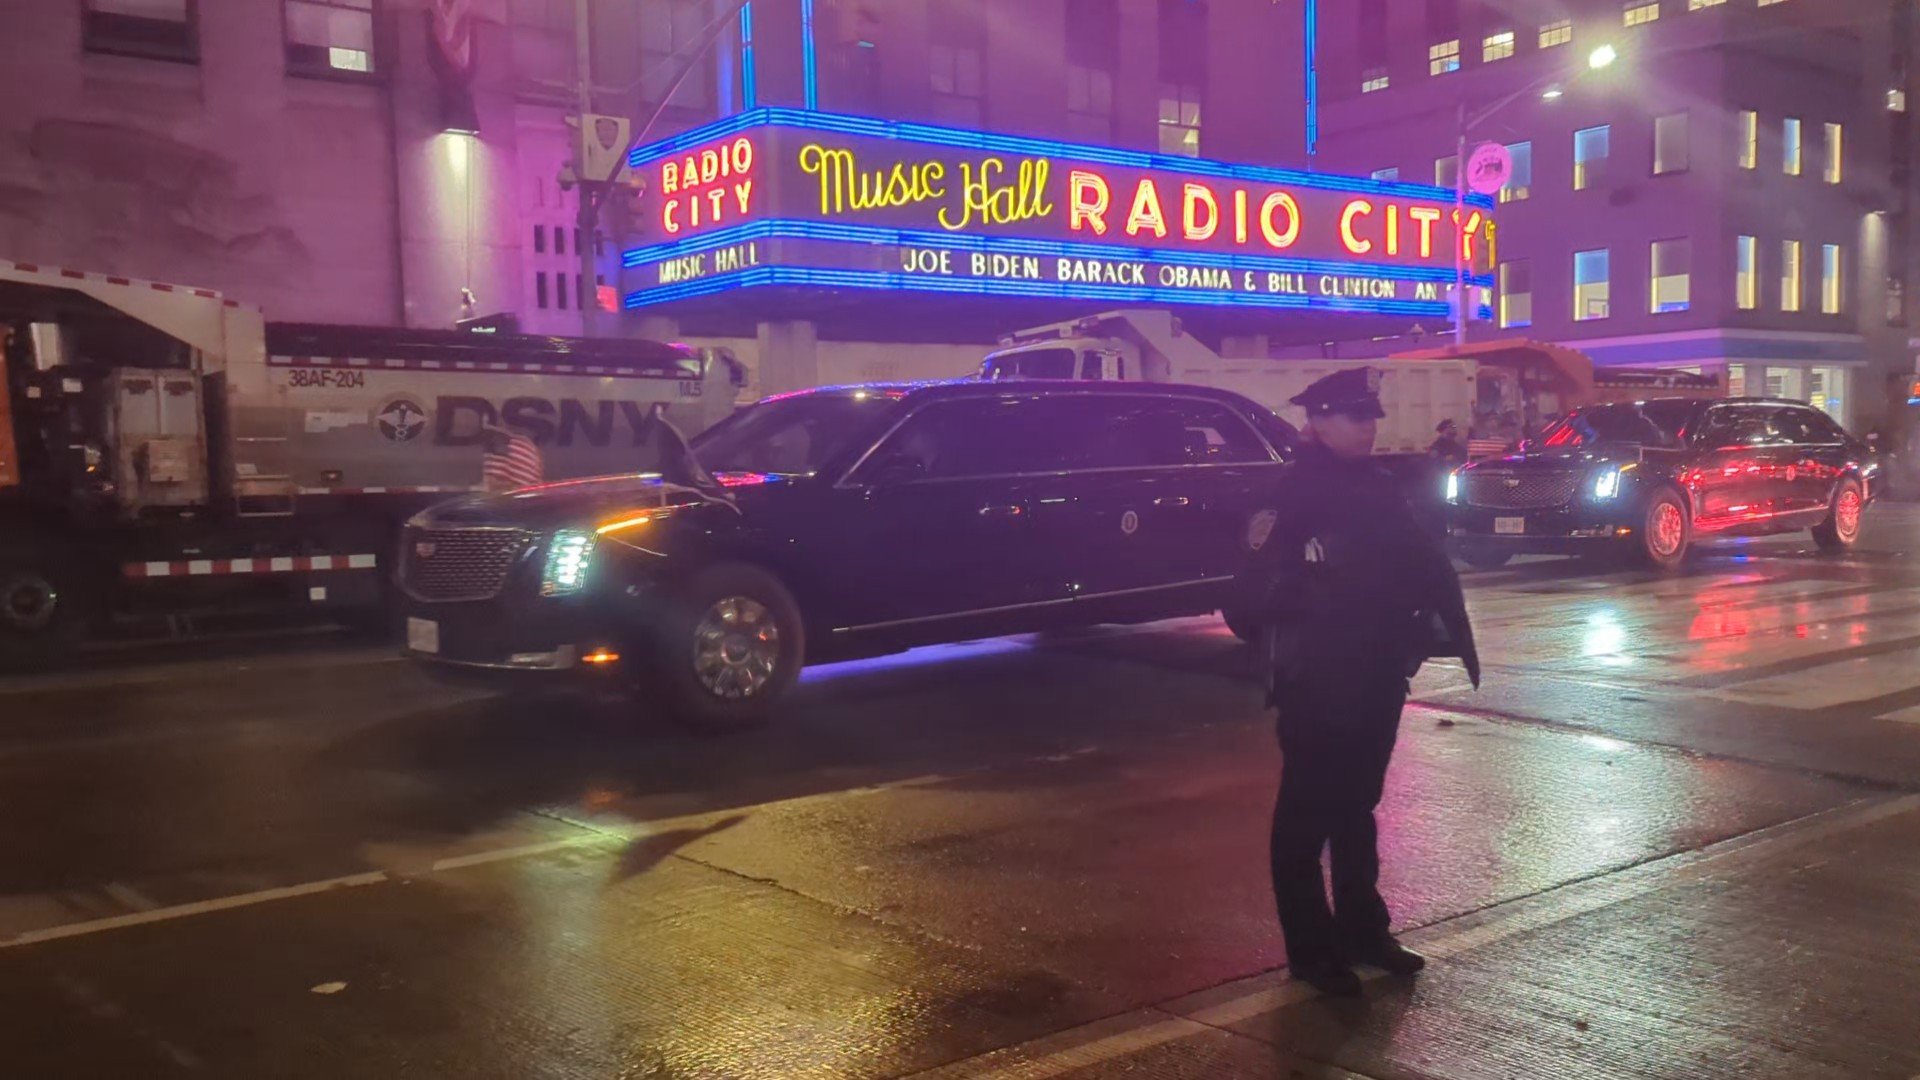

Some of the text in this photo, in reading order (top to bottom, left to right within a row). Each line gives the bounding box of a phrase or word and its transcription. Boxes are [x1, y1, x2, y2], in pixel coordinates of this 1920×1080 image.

[662, 137, 753, 195] RADIO
[799, 143, 1053, 231] Music Hall
[663, 180, 752, 234] CITY
[1069, 170, 1300, 249] RADIO
[1340, 199, 1482, 260] CITY
[658, 241, 760, 284] MUSIC HALL
[903, 249, 953, 274] JOE
[1057, 258, 1146, 285] BARACK
[1158, 264, 1233, 290] OBAMA
[1244, 270, 1257, 292] &
[1267, 271, 1308, 295] BILL
[1319, 275, 1396, 299] CLINTON
[1414, 281, 1438, 301] AN
[288, 369, 365, 388] 38AF-204
[434, 395, 670, 447] DSNY
